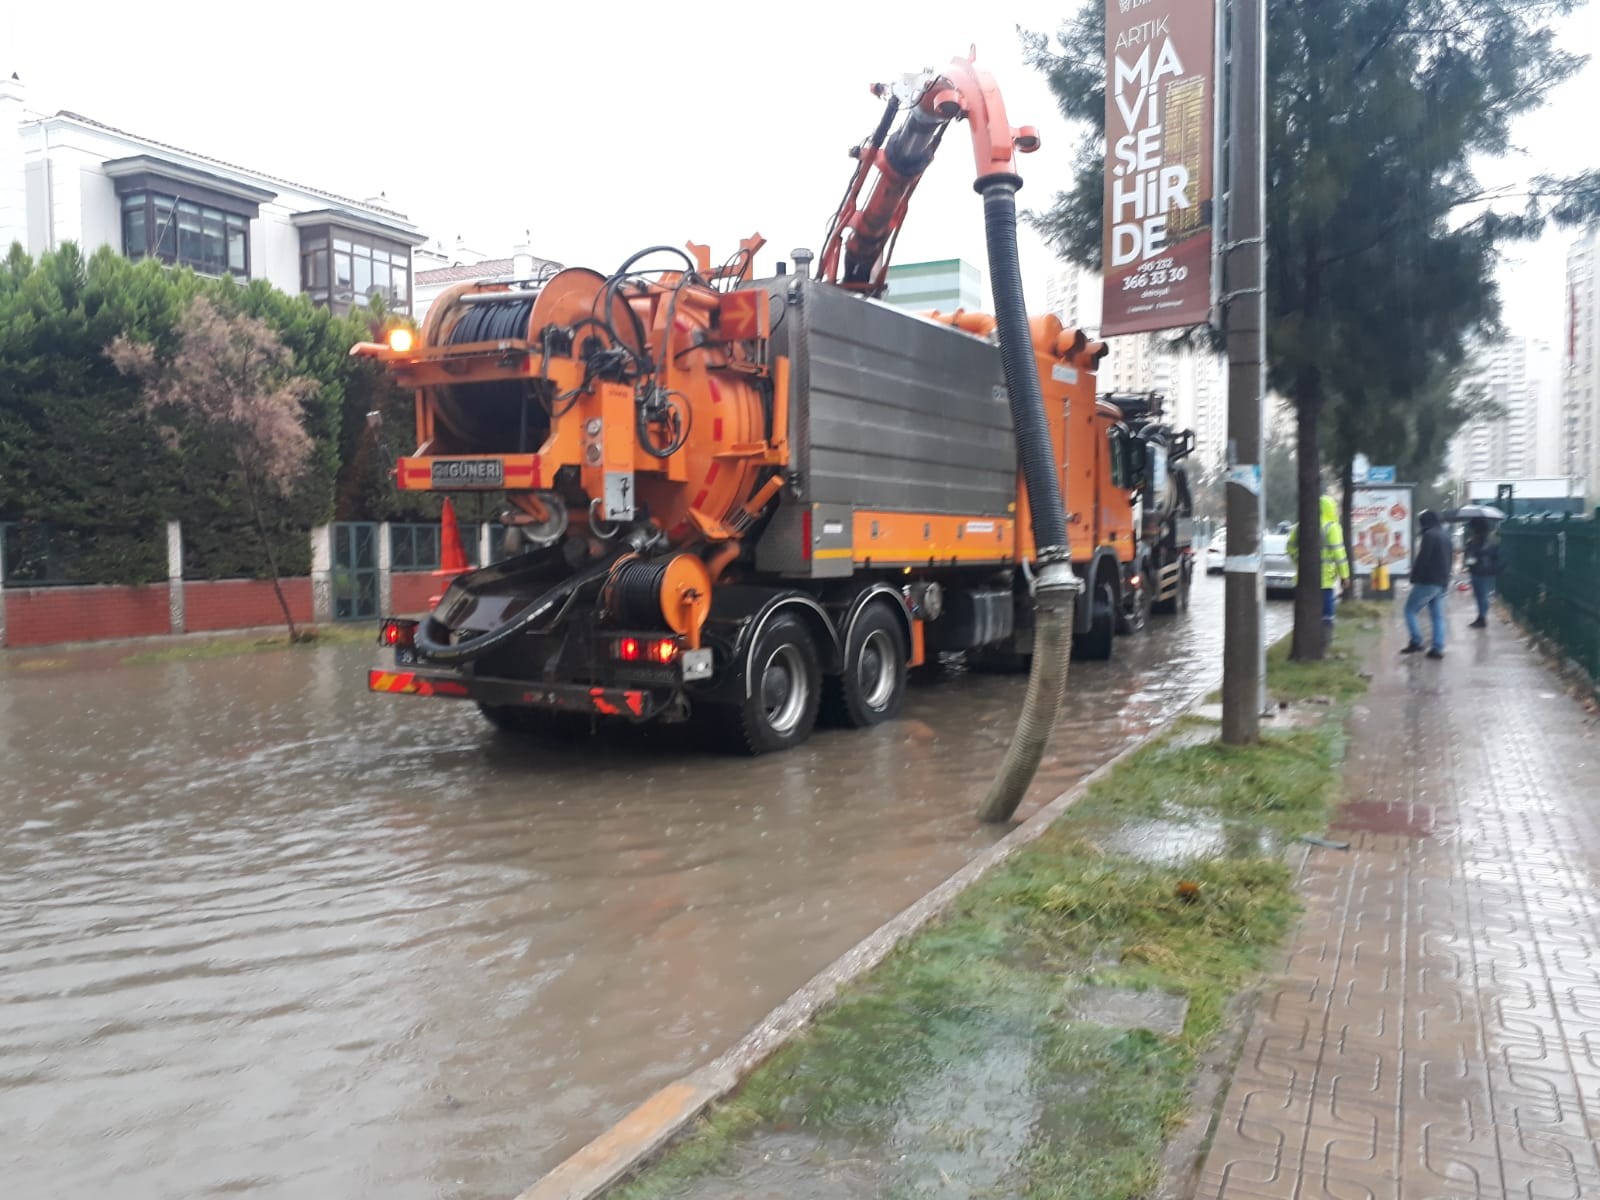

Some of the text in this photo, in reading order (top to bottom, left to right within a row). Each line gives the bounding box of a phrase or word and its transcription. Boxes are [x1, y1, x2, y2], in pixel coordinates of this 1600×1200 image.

[1114, 14, 1170, 52] ARTIK
[1114, 35, 1184, 97] MA
[1111, 213, 1169, 267] DE
[1122, 264, 1188, 290] 366 33 30
